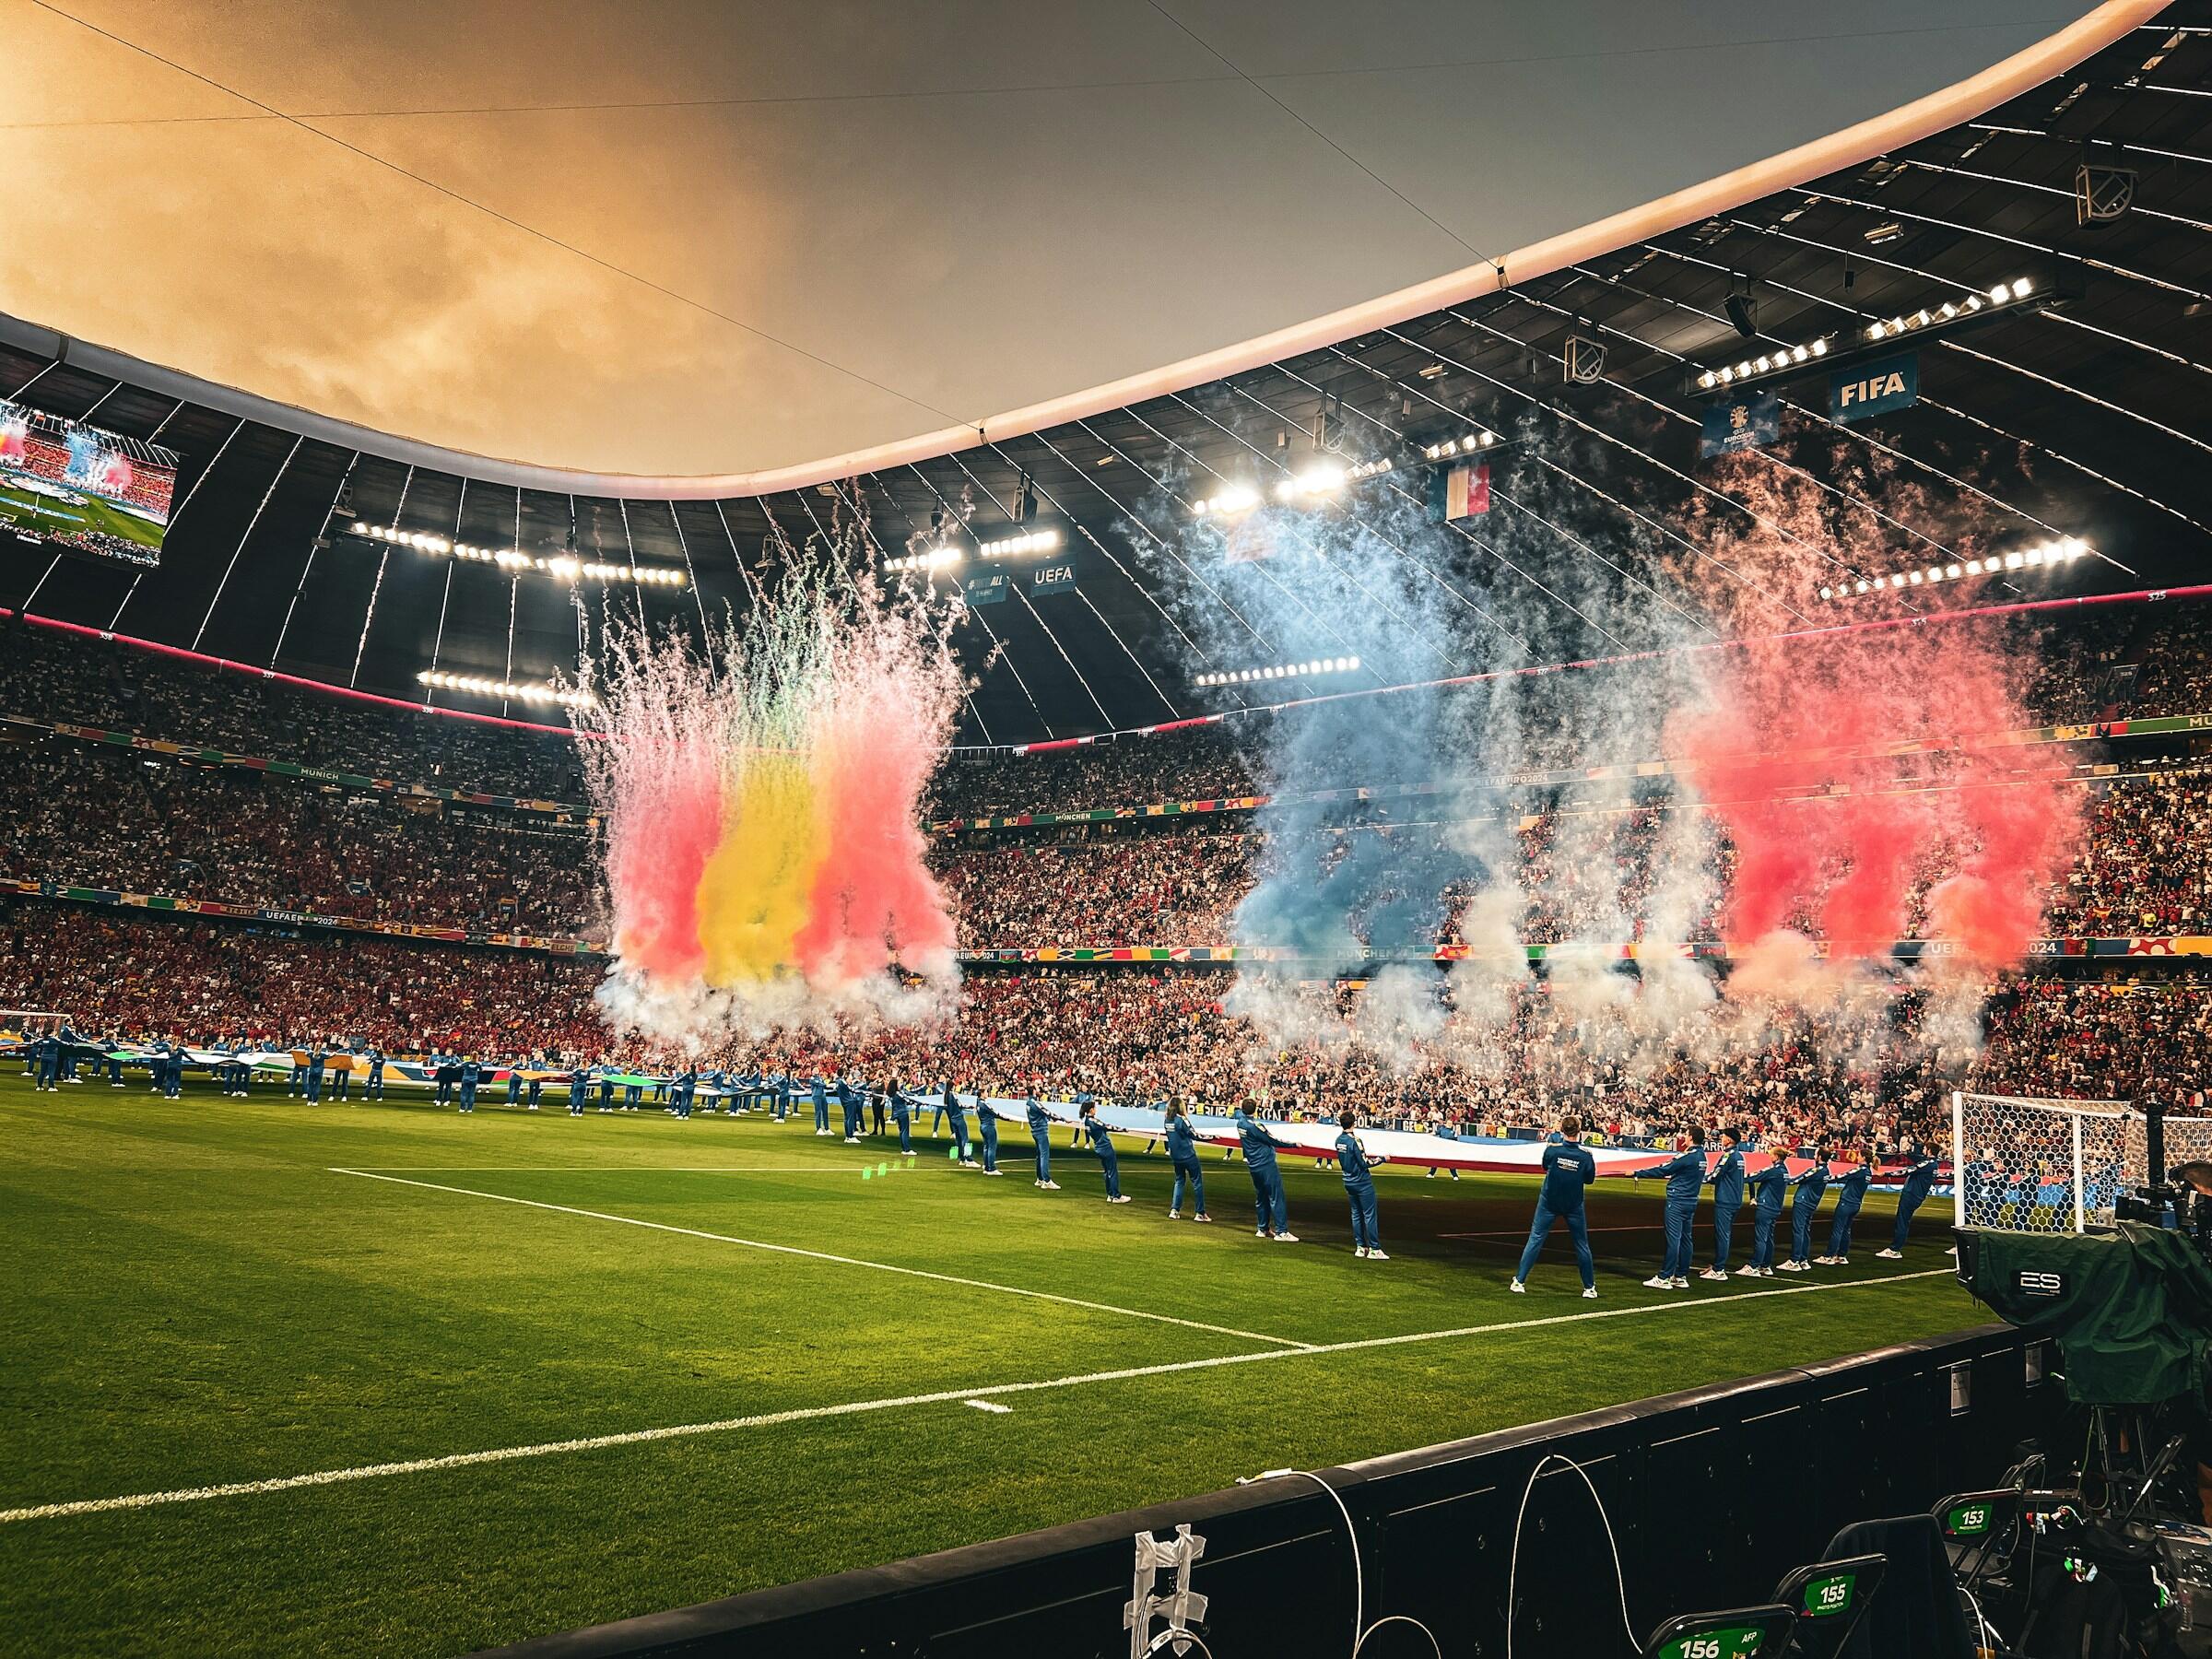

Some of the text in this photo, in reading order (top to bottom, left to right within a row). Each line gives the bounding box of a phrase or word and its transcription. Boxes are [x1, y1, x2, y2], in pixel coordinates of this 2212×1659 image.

[1841, 372, 1906, 407] FIFA
[1035, 567, 1073, 584] UEFA
[2148, 591, 2166, 601] 325
[301, 768, 339, 781] MUNICH
[1055, 812, 1091, 821] MÜNCHEN
[2020, 1272, 2061, 1289] ES
[1962, 1511, 1984, 1525] 153
[1821, 1583, 1846, 1604] 155
[1741, 1631, 1758, 1643] AFP
[1680, 1640, 1720, 1659] 156
